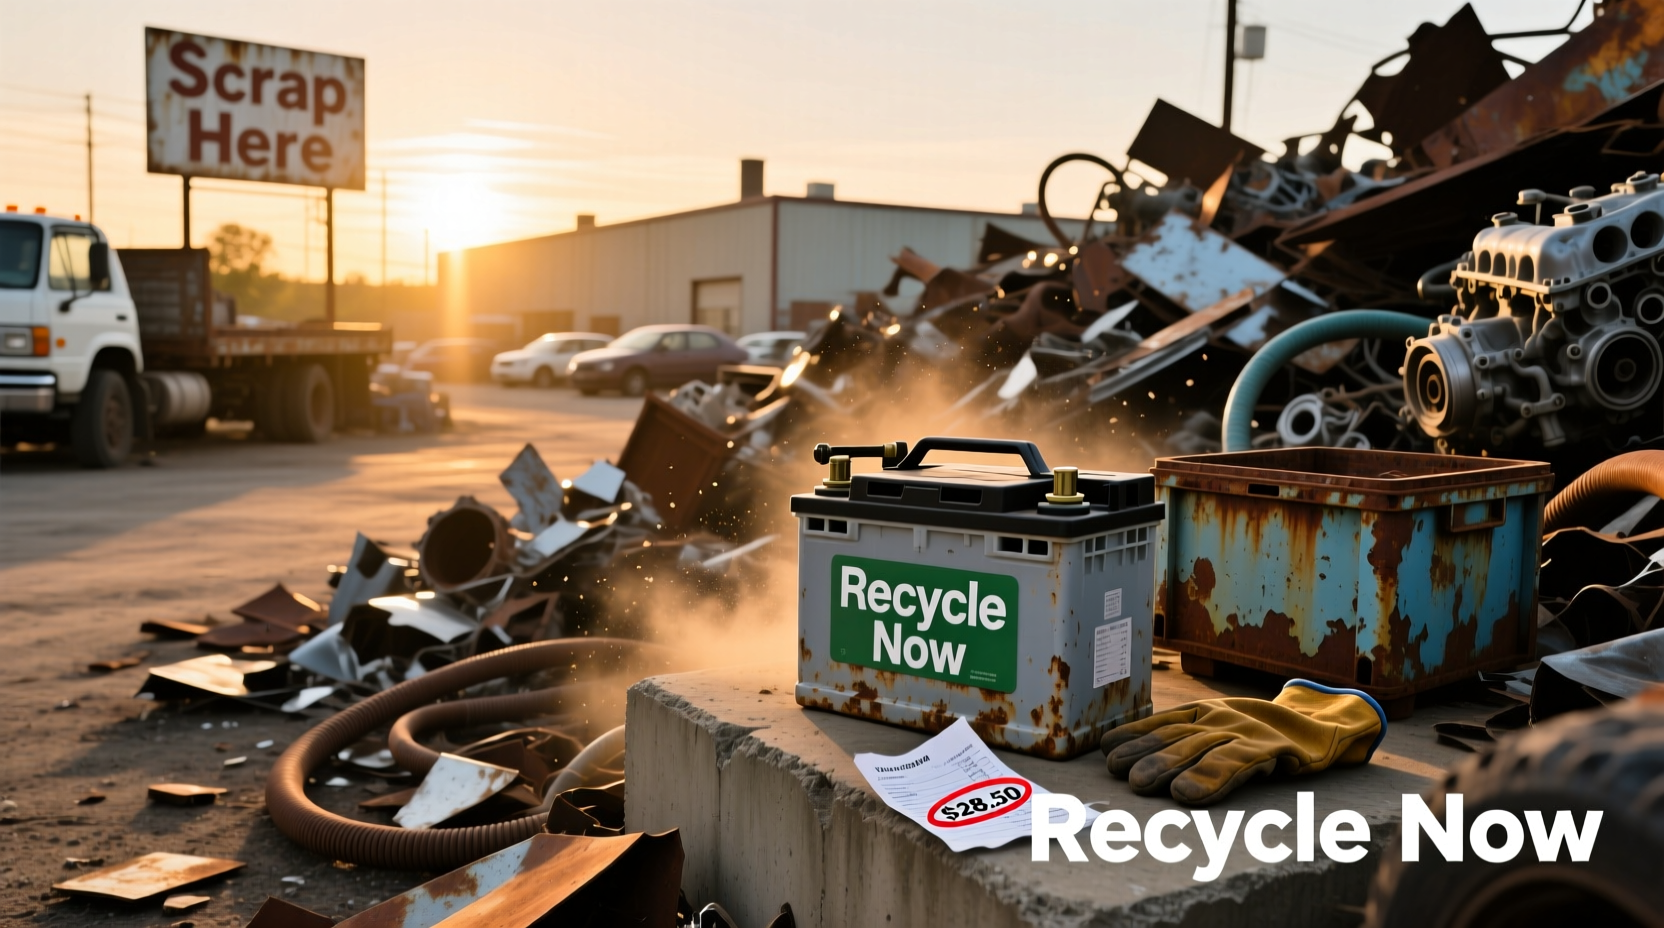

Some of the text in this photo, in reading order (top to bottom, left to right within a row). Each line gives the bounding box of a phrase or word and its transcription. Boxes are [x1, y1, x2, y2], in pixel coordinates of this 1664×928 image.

[168, 40, 346, 127] Scrap
[188, 108, 333, 174] Here
[840, 565, 1007, 631] Recycle
[873, 619, 967, 676] Now
[941, 786, 1022, 821] $28.50
